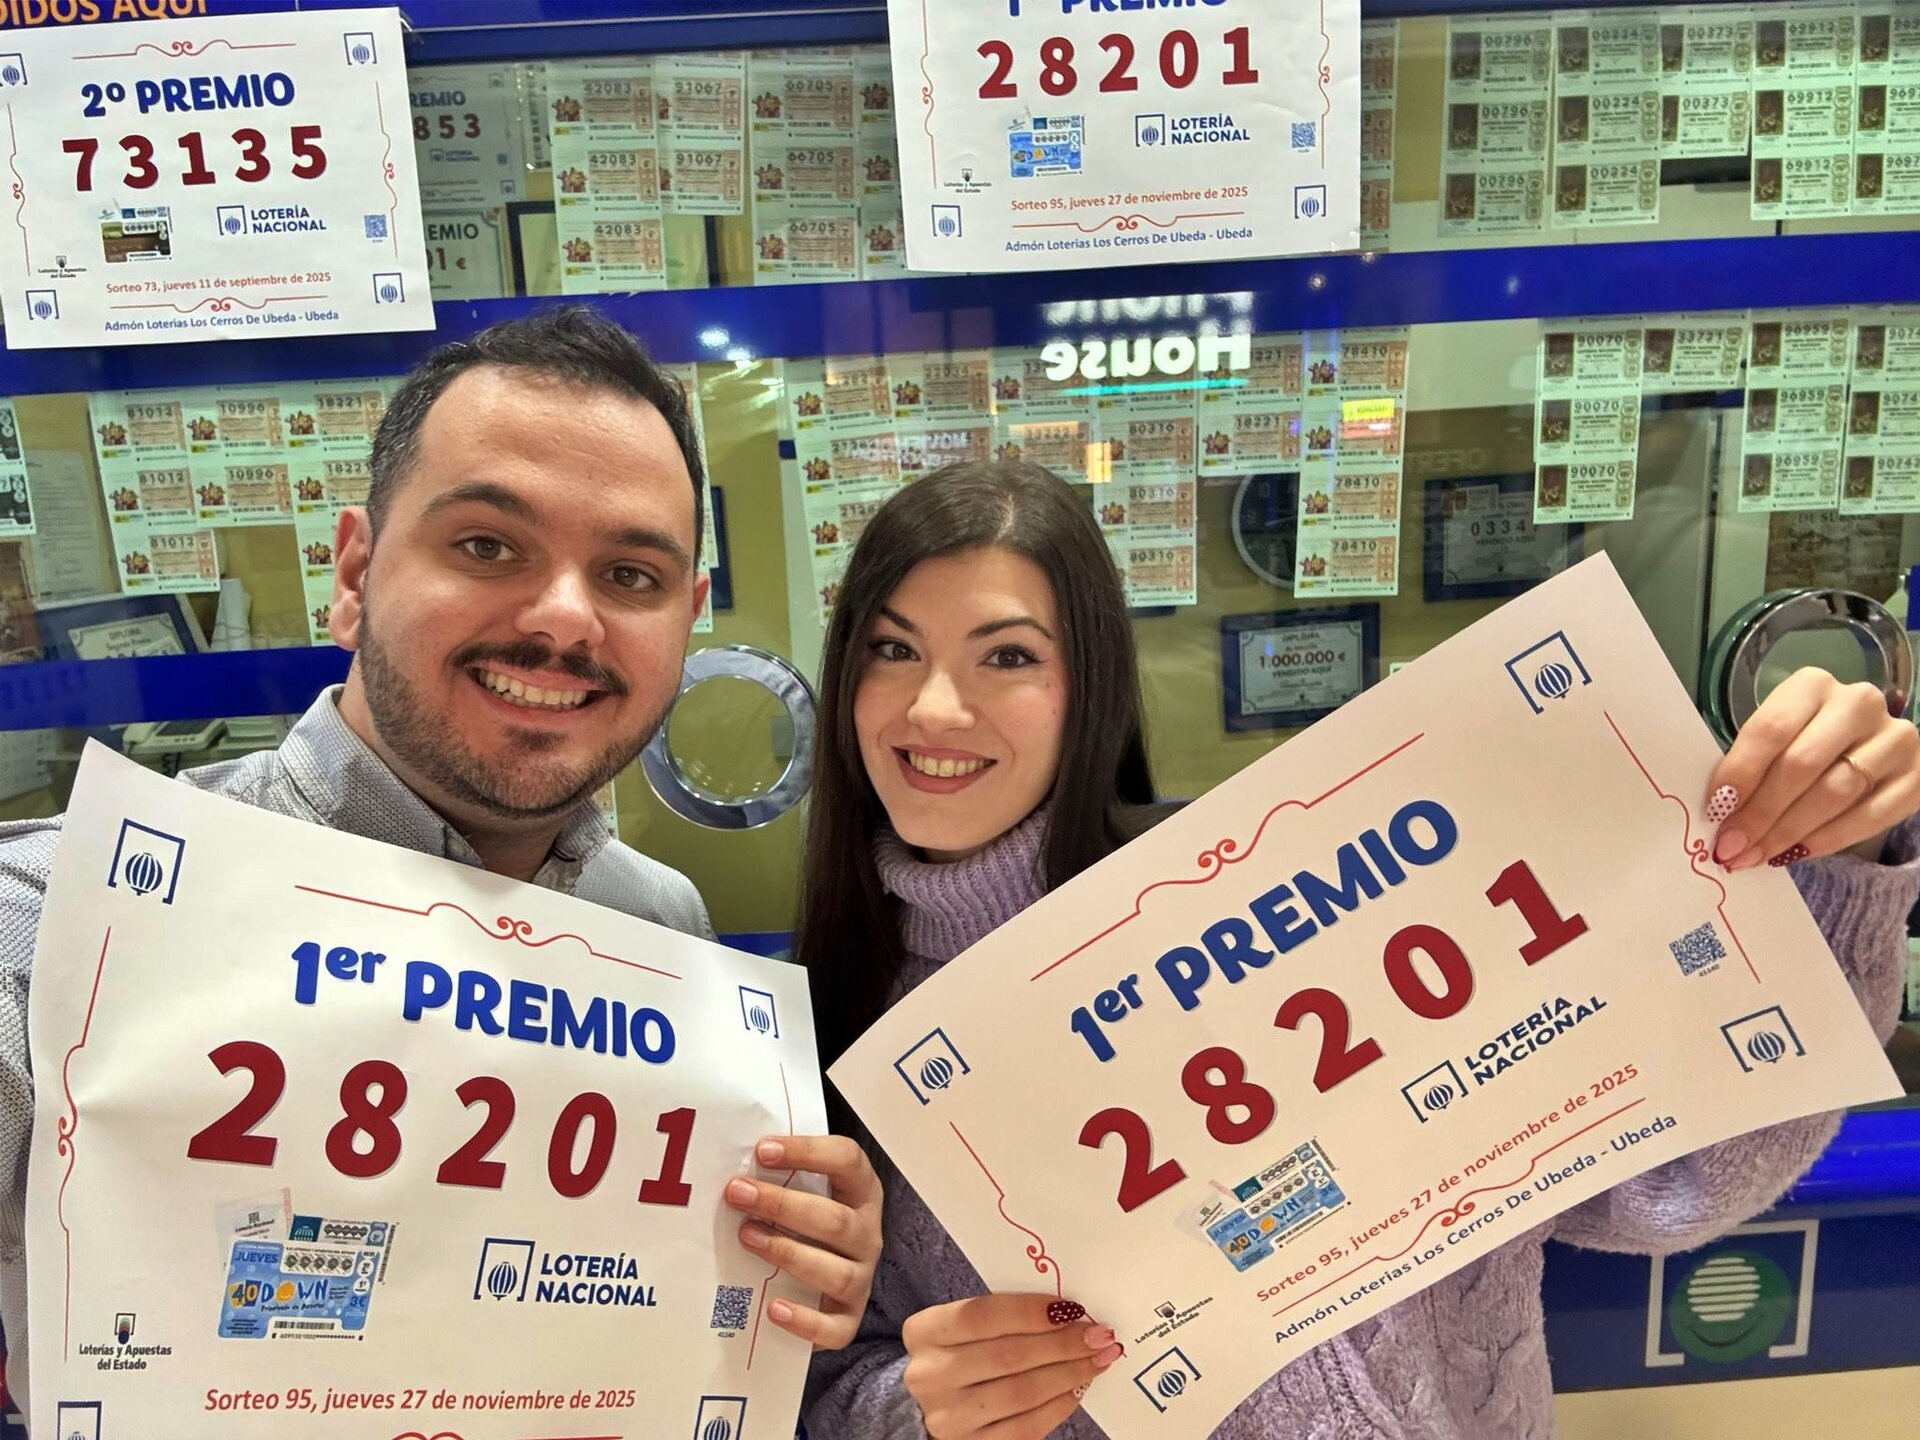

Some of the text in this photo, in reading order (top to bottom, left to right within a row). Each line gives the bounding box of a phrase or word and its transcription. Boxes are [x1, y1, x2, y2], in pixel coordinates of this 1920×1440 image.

[976, 27, 1259, 99] 28201
[135, 71, 296, 115] PREMIO
[1889, 87, 1920, 101] 969
[1171, 113, 1235, 131] LOTERÍA
[1171, 129, 1251, 145] NACIONAL
[62, 124, 328, 193] 73135
[1011, 186, 1249, 211] Sorteo 95, jueves 27 de noviembre de 2025
[250, 204, 310, 221] LOTERÍA
[252, 218, 327, 234] NACIONAL
[1005, 240, 1045, 252] Admón
[1047, 237, 1091, 251] Loterias
[1093, 236, 1112, 248] Los
[1114, 234, 1150, 247] Cerros
[1152, 233, 1168, 244] De
[1170, 231, 1207, 243] Ubeda
[1216, 228, 1253, 240] Ubeda
[105, 271, 332, 294] Sorteo 73, jueves 11 de septiembre de 2025
[104, 320, 145, 332] Admón
[146, 317, 189, 330] Loterias
[191, 316, 208, 327] Los
[210, 315, 244, 327] Cerros
[246, 313, 261, 325] De
[263, 311, 296, 324] Ubeda
[305, 310, 340, 322] Ubeda
[1471, 518, 1539, 537] 0334
[1070, 799, 1459, 1064] 1er PREMIO
[291, 941, 677, 1065] 1er PREMIO
[1077, 858, 1590, 1214] 28201
[1464, 996, 1573, 1071] LOTERÍA
[1473, 995, 1608, 1087] NACIONAL
[186, 1040, 698, 1208] 28201
[1256, 1063, 1640, 1303] Sorteo 95, jueves 27 de noviembre de 2025
[1274, 1304, 1339, 1345] Admón
[1339, 1263, 1413, 1307] Loterias
[1413, 1241, 1445, 1267] Los
[1446, 1204, 1505, 1247] Cerros
[1505, 1186, 1534, 1211] De
[1534, 1149, 1599, 1194] Ubeda
[1610, 1111, 1679, 1153] Ubeda
[234, 1251, 279, 1264] JUEVES
[540, 1252, 639, 1280] LOTERÍA
[535, 1281, 658, 1307] NACIONAL
[125, 1344, 173, 1357] Apuestas
[97, 1358, 147, 1370] del Estado
[204, 1387, 637, 1415] Sorteo 95, jueves 27 de noviembre de 2025
